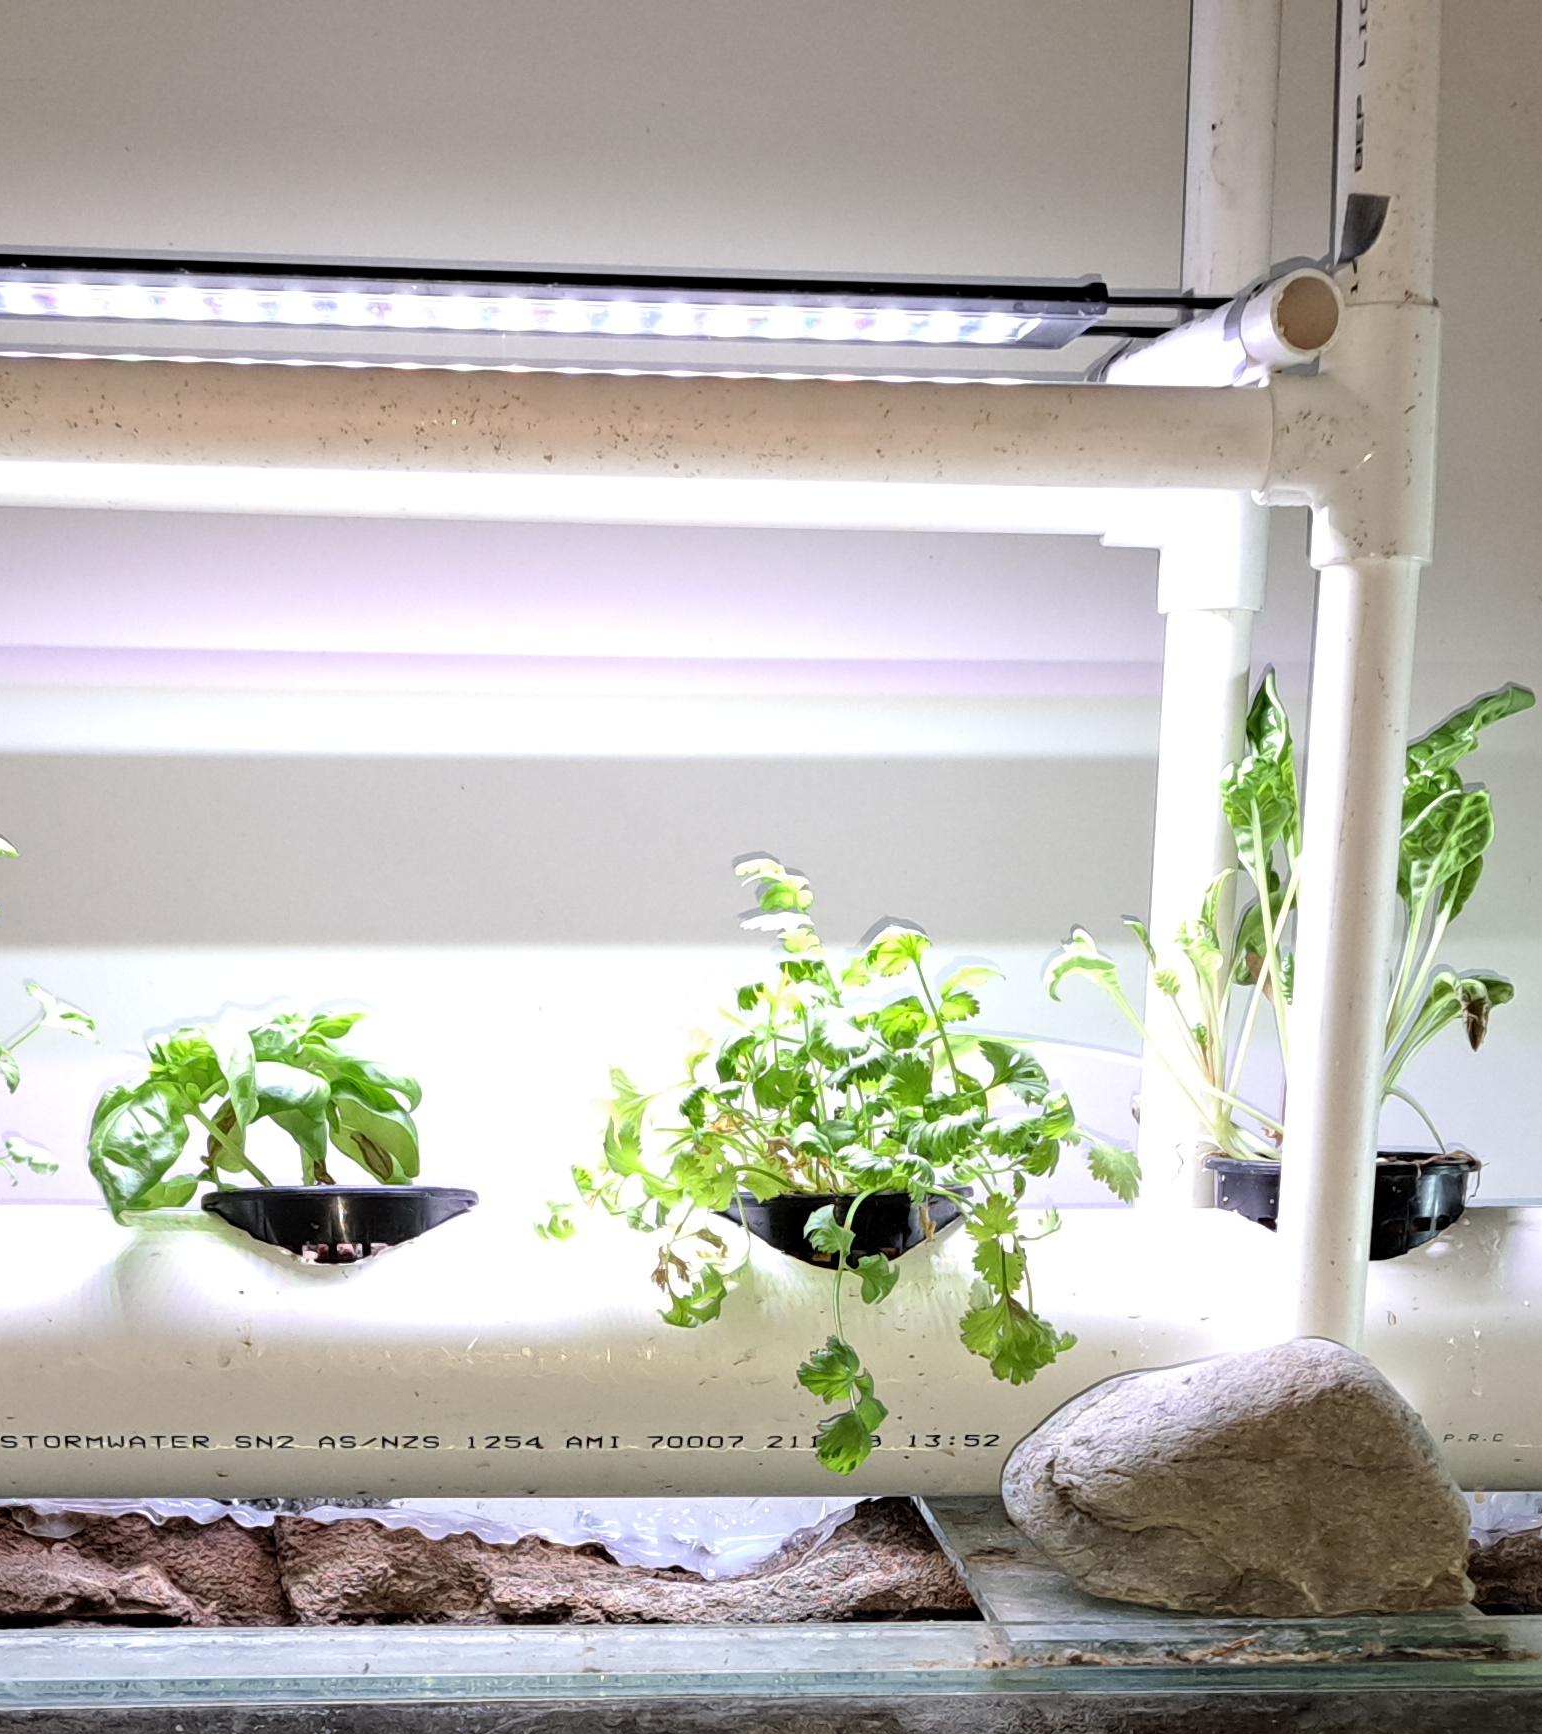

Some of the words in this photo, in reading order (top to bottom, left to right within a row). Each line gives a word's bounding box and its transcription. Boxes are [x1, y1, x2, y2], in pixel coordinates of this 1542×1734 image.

[0, 1435, 210, 1449] STORMWATER
[235, 1435, 295, 1449] SN2
[318, 1435, 440, 1449] AS/NZS
[467, 1435, 544, 1449] 1254
[566, 1435, 620, 1449] AMI
[647, 1435, 744, 1449] 70007
[908, 1434, 1000, 1448] 13:52
[1442, 1433, 1504, 1443] P.R.C
